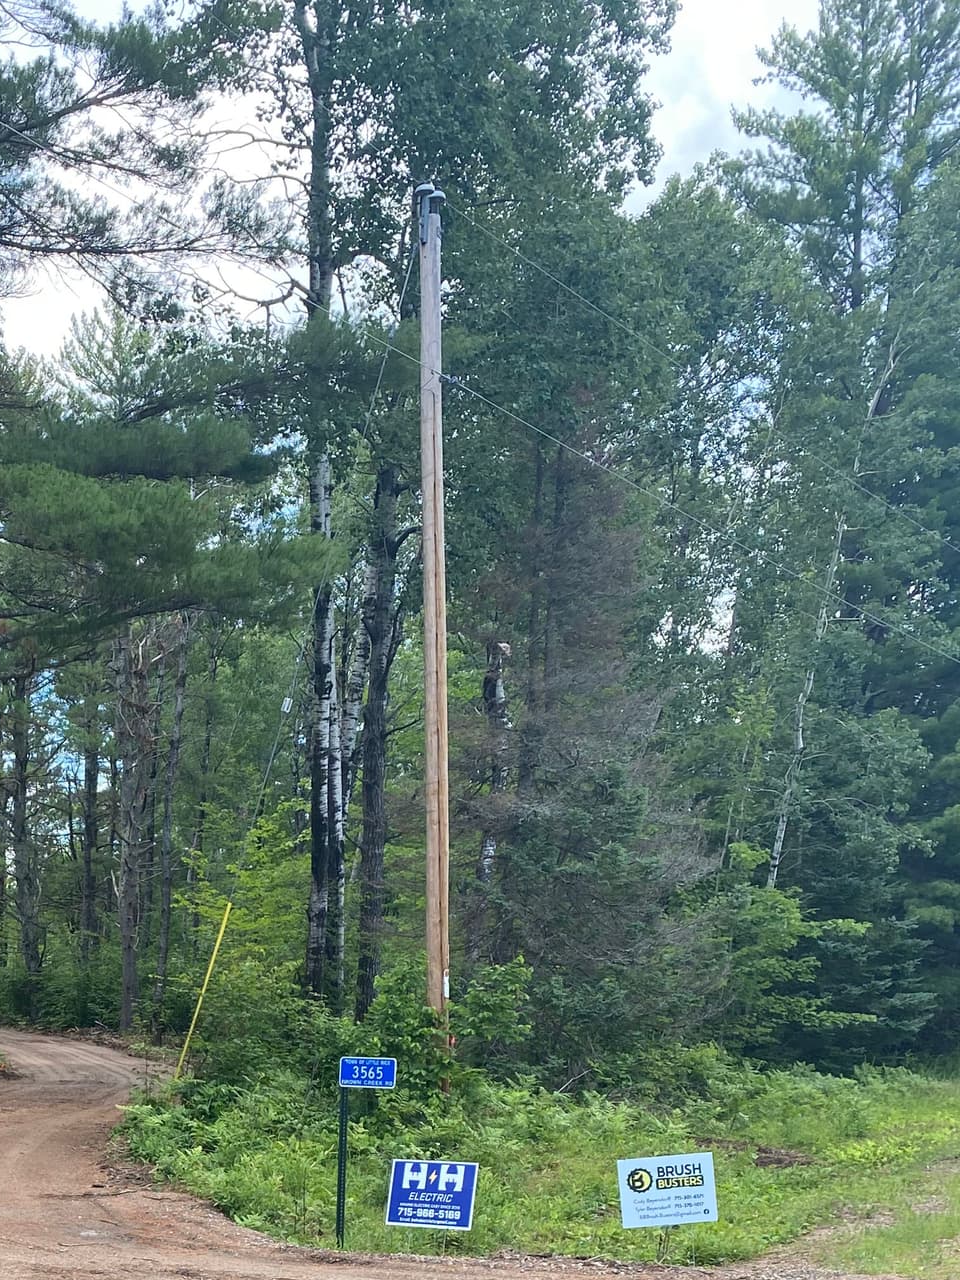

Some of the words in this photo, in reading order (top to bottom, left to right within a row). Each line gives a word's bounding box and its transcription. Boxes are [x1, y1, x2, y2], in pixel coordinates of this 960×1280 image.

[352, 1065, 383, 1080] 3565
[402, 1162, 429, 1190] H
[438, 1164, 465, 1192] H
[657, 1162, 702, 1177] BRUSH
[657, 1175, 703, 1189] BUSTERS
[408, 1191, 453, 1203] ELECTRIC
